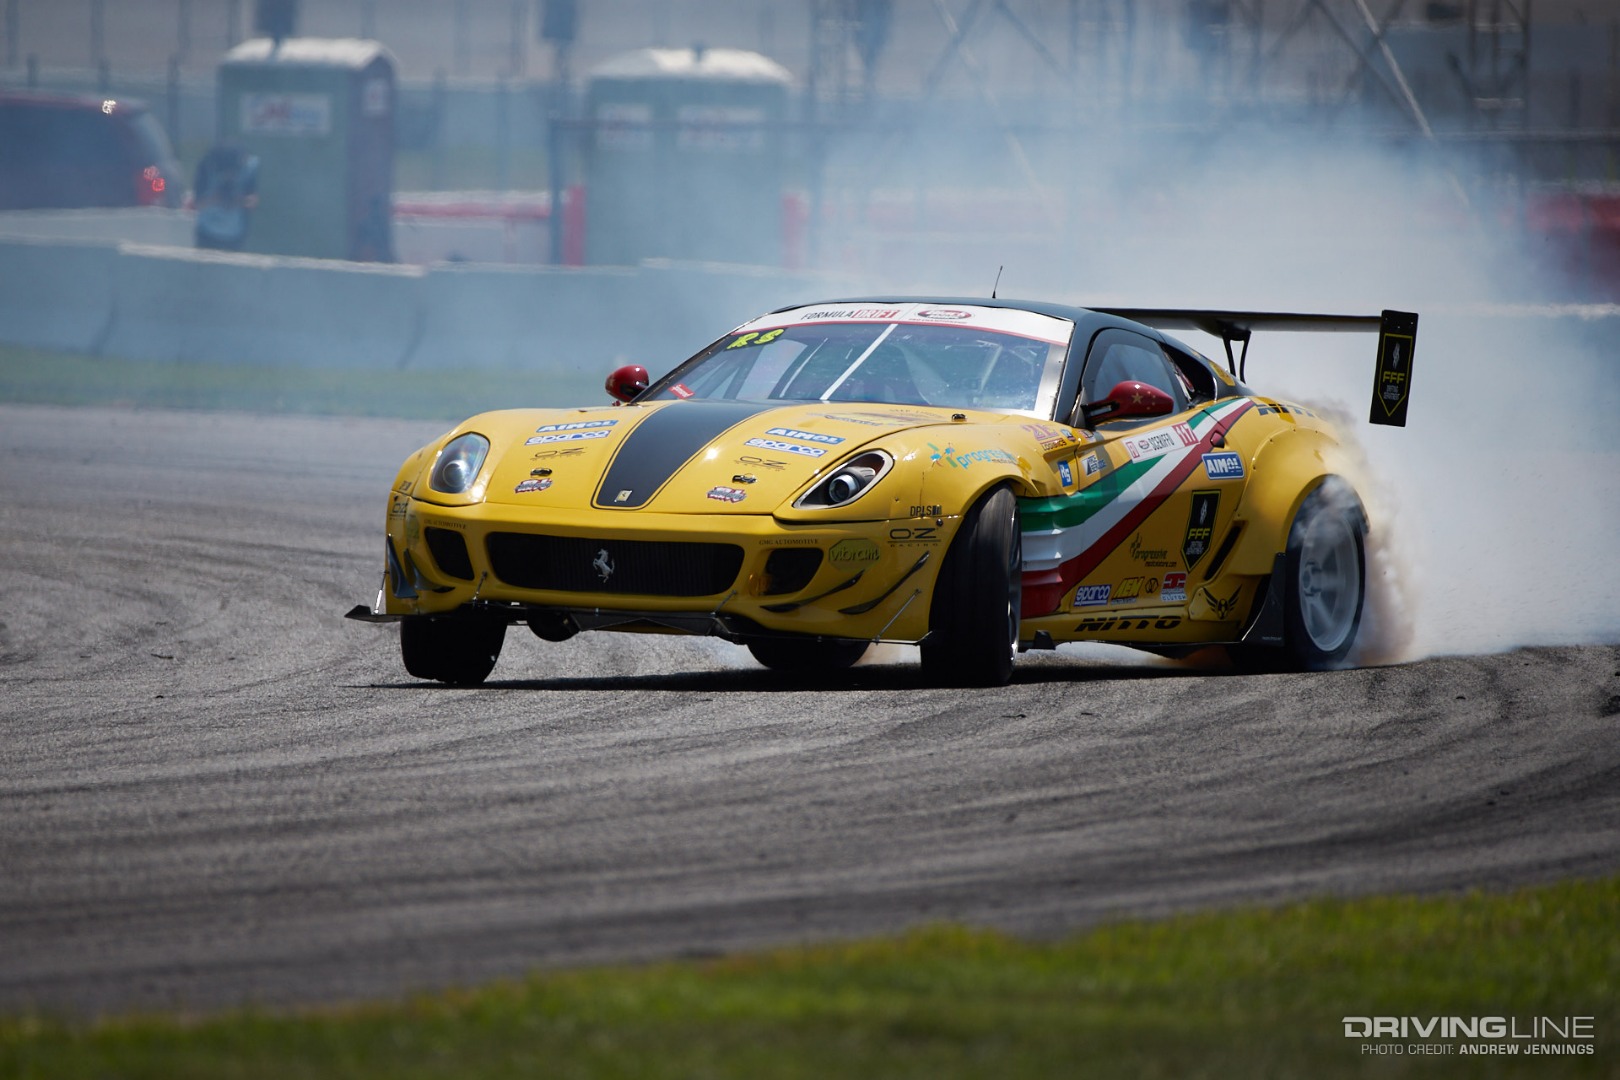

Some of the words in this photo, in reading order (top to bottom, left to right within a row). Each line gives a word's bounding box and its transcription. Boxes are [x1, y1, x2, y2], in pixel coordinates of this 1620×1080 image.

[801, 310, 852, 320] FORMULA
[1382, 371, 1405, 384] FFF
[528, 430, 610, 444] sparco
[1175, 423, 1196, 444] 117
[748, 438, 826, 456] sparco
[1188, 528, 1211, 540] FFF
[1076, 585, 1111, 602] sparco
[1112, 576, 1145, 599] AEM
[1074, 615, 1181, 632] NITTO
